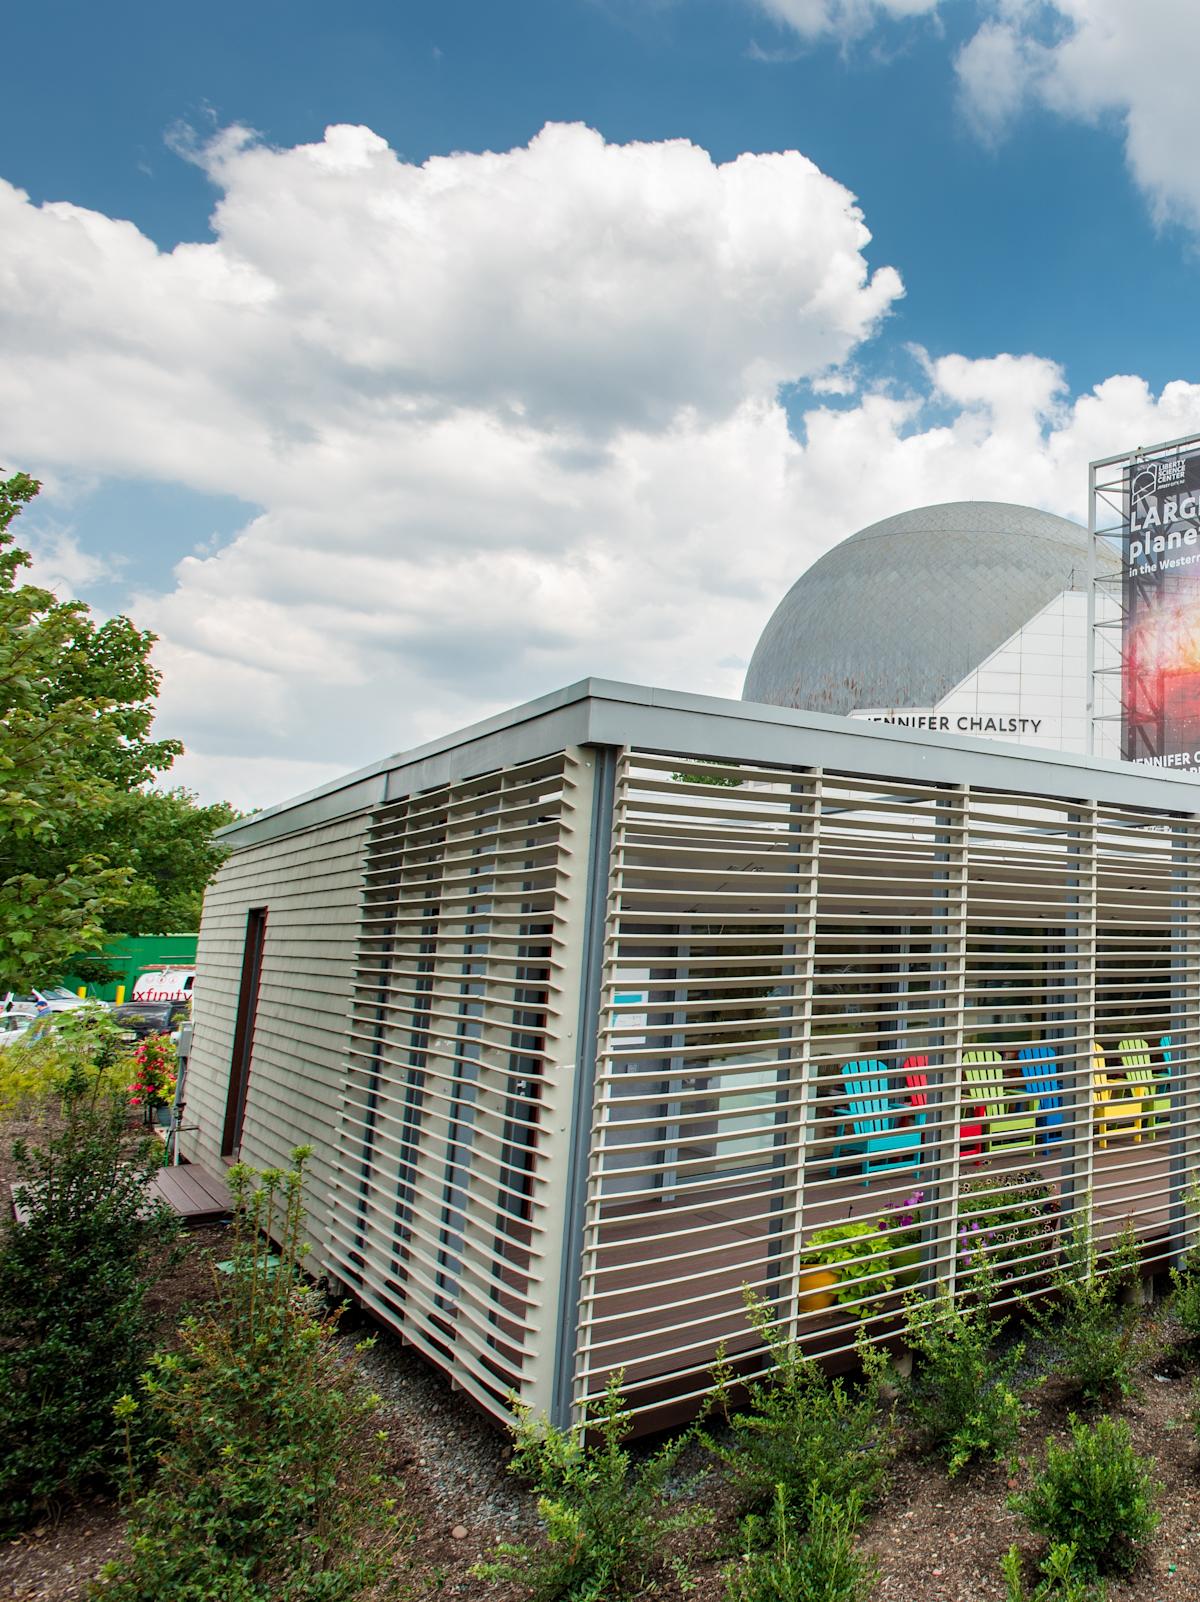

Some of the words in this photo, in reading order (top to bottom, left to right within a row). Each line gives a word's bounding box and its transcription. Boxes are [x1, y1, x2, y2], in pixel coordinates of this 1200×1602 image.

[1158, 459, 1186, 471] LIBERTY
[1158, 464, 1186, 478] SCIENCE
[1157, 471, 1185, 483] CENTER
[1129, 567, 1138, 578] in
[1140, 563, 1157, 574] the
[868, 716, 949, 730] NIFER
[957, 717, 1042, 733] CHALSTY
[137, 988, 193, 1001] xfinity
